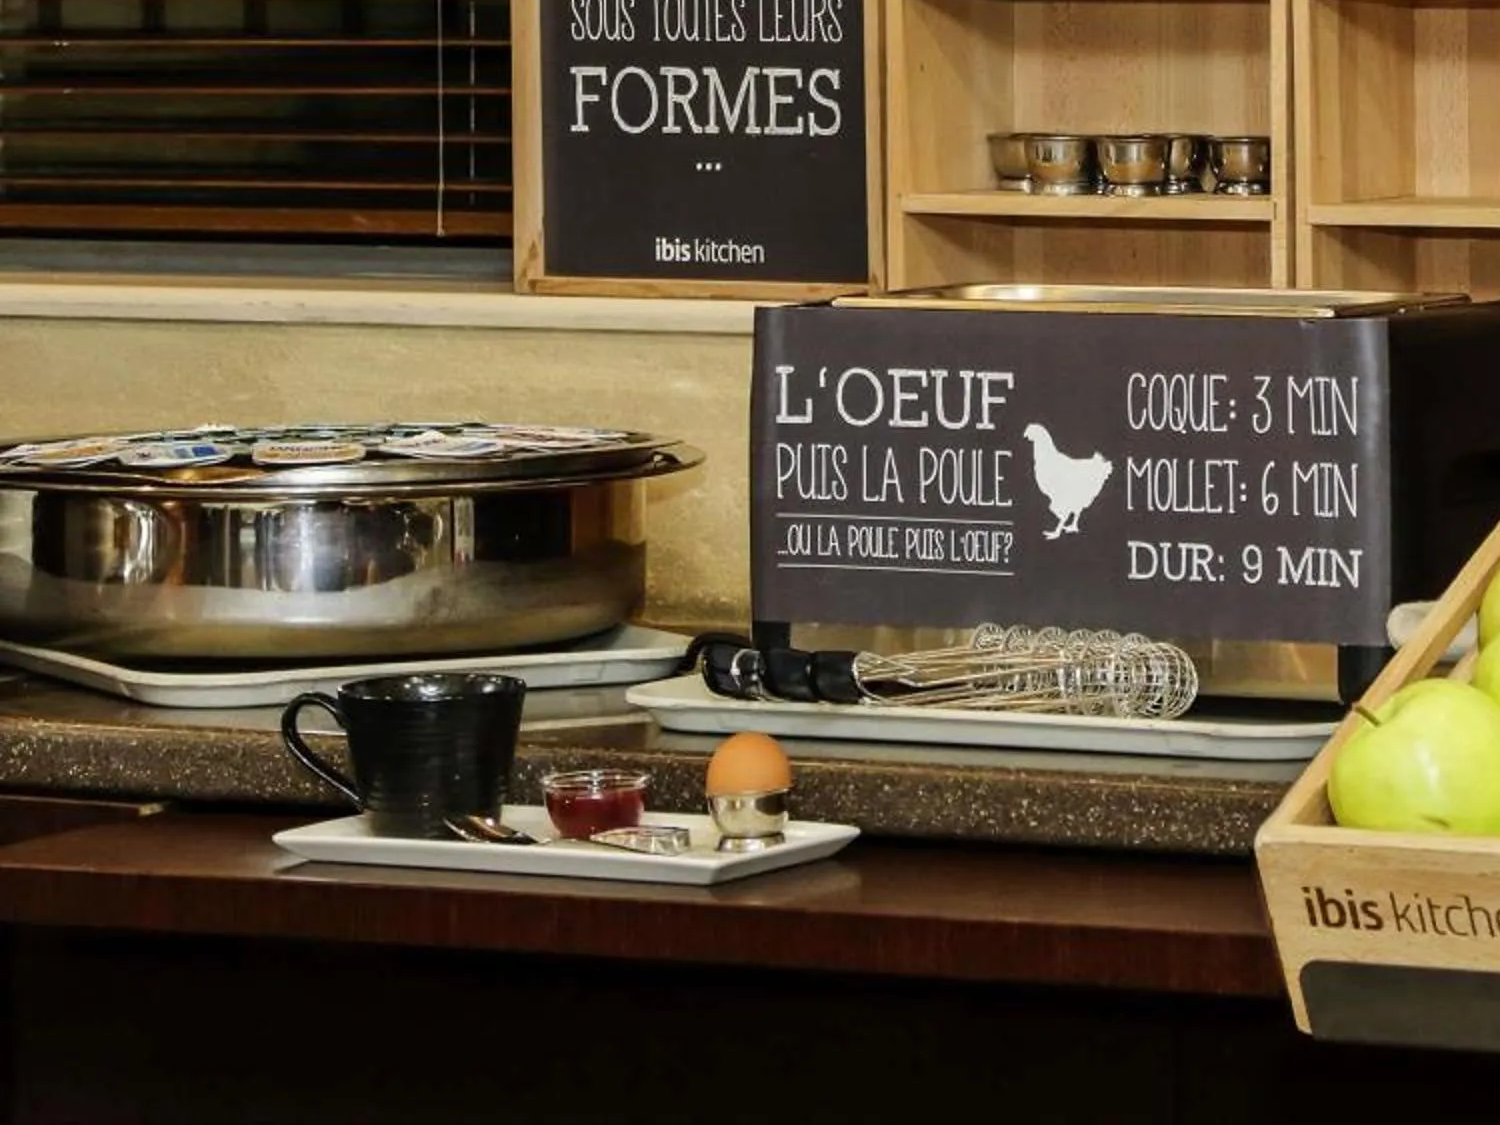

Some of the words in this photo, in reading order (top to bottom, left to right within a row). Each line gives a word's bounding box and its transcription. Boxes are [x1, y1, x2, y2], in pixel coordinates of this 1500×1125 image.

[569, 65, 841, 137] FORMES
[655, 237, 691, 262] ibis
[694, 238, 765, 264] kitchen
[775, 364, 1015, 430] L'OEUF
[1127, 372, 1237, 435] COQUE:
[1252, 375, 1273, 434] 3
[1287, 375, 1359, 436] MIN
[775, 442, 849, 501] PUIS
[862, 444, 905, 504] LA
[919, 446, 1013, 507] POULE
[1126, 456, 1247, 514] MOLLET:
[1261, 460, 1279, 516] 6
[1292, 460, 1359, 518] MIN
[817, 524, 841, 556] LA
[847, 524, 899, 559] POULE
[905, 527, 945, 561] PUIS
[950, 529, 1014, 564] L'OEUF?
[1127, 540, 1225, 582] DUR:
[1241, 544, 1263, 584] 9
[1276, 546, 1364, 589] MIN
[1302, 886, 1384, 931] ibis
